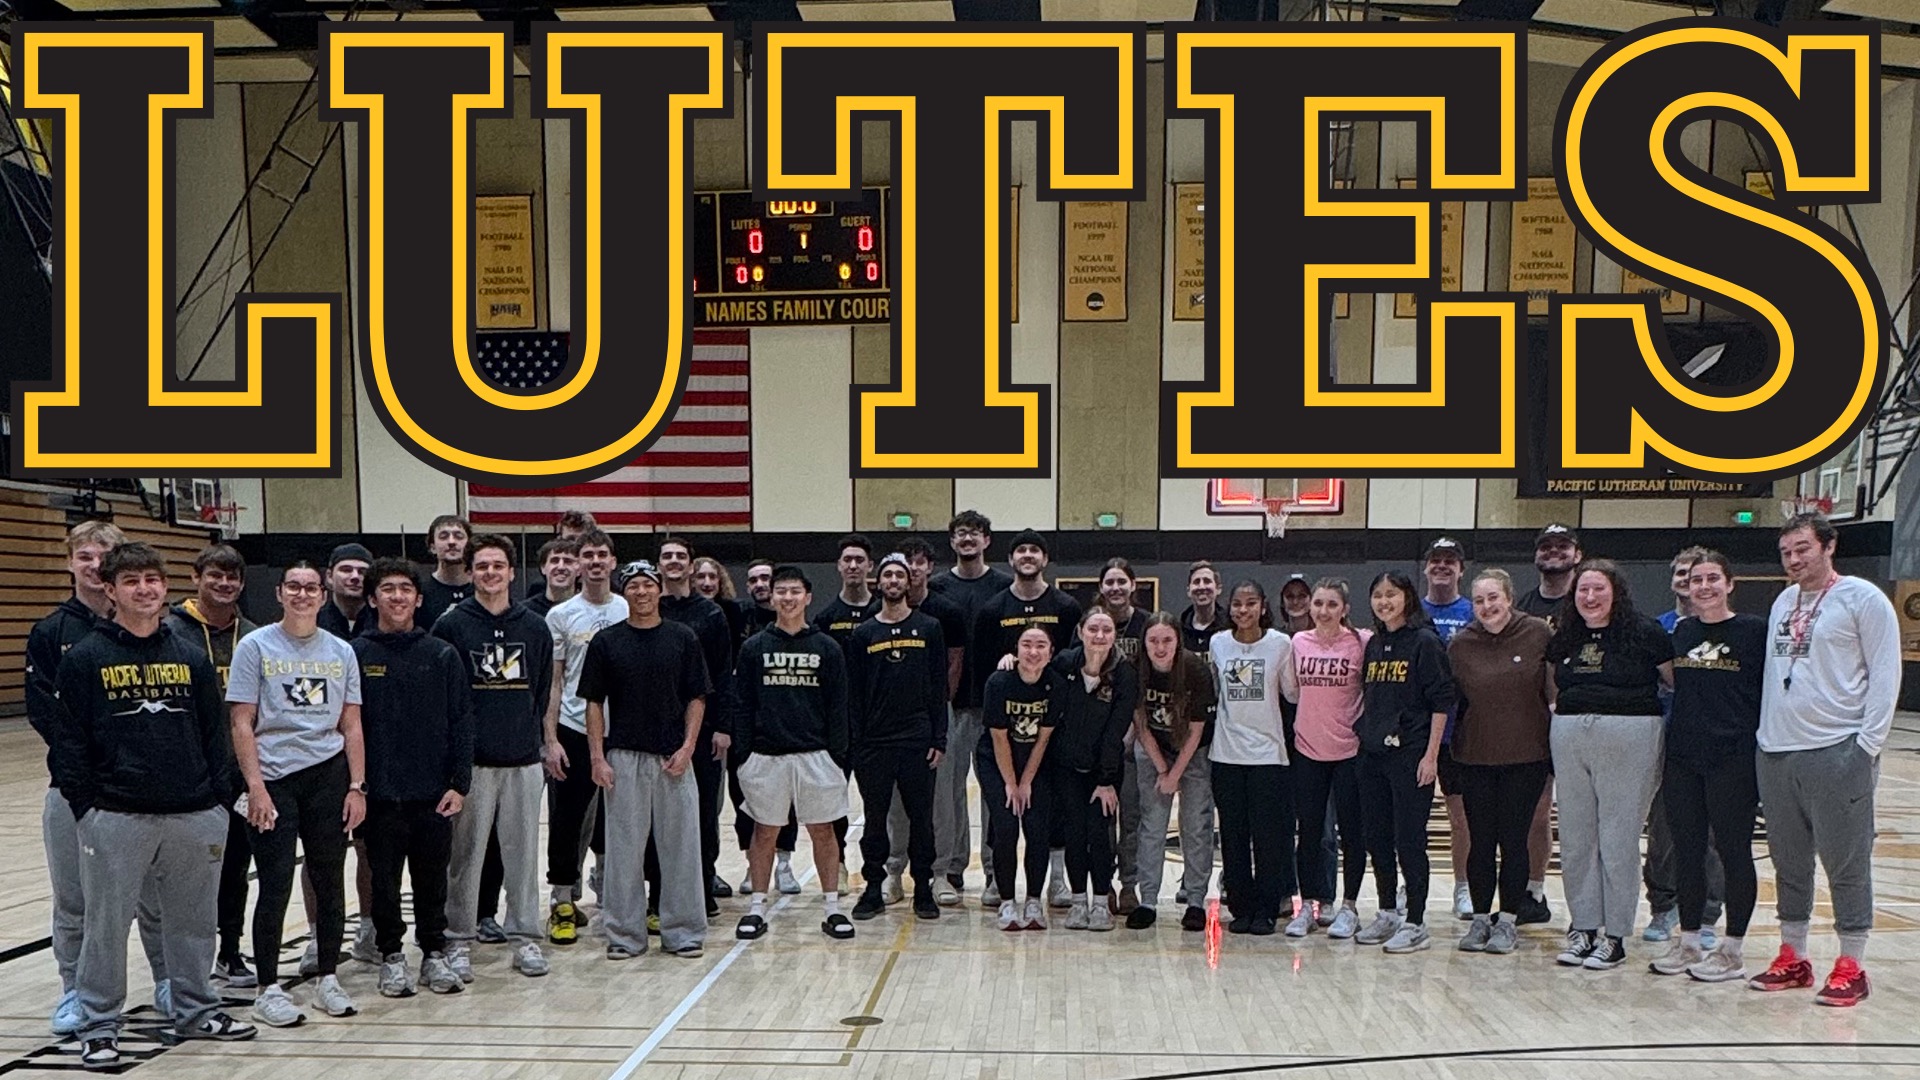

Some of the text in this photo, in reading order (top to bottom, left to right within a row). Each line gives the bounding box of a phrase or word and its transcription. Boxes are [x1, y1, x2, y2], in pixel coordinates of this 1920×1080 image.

[731, 218, 760, 230] LUTES
[840, 216, 871, 227] GUEST
[749, 230, 763, 254] 0
[800, 232, 807, 249] 1
[858, 226, 873, 251] 0
[736, 266, 748, 284] 0
[866, 261, 878, 281] 0
[1073, 265, 1117, 273] NATIONAL
[1514, 272, 1569, 281] CHAMPIONS
[1069, 276, 1122, 284] CHAMPIONS
[705, 298, 890, 323] NAMES FAMILY COUR
[1547, 480, 1596, 492] PACIFIC
[1599, 479, 1666, 492] LUTHERAN
[763, 652, 821, 668] LUTES
[1299, 657, 1350, 676] LUTES
[763, 675, 820, 687] BASEBALL
[108, 687, 191, 701] BASEBALL
